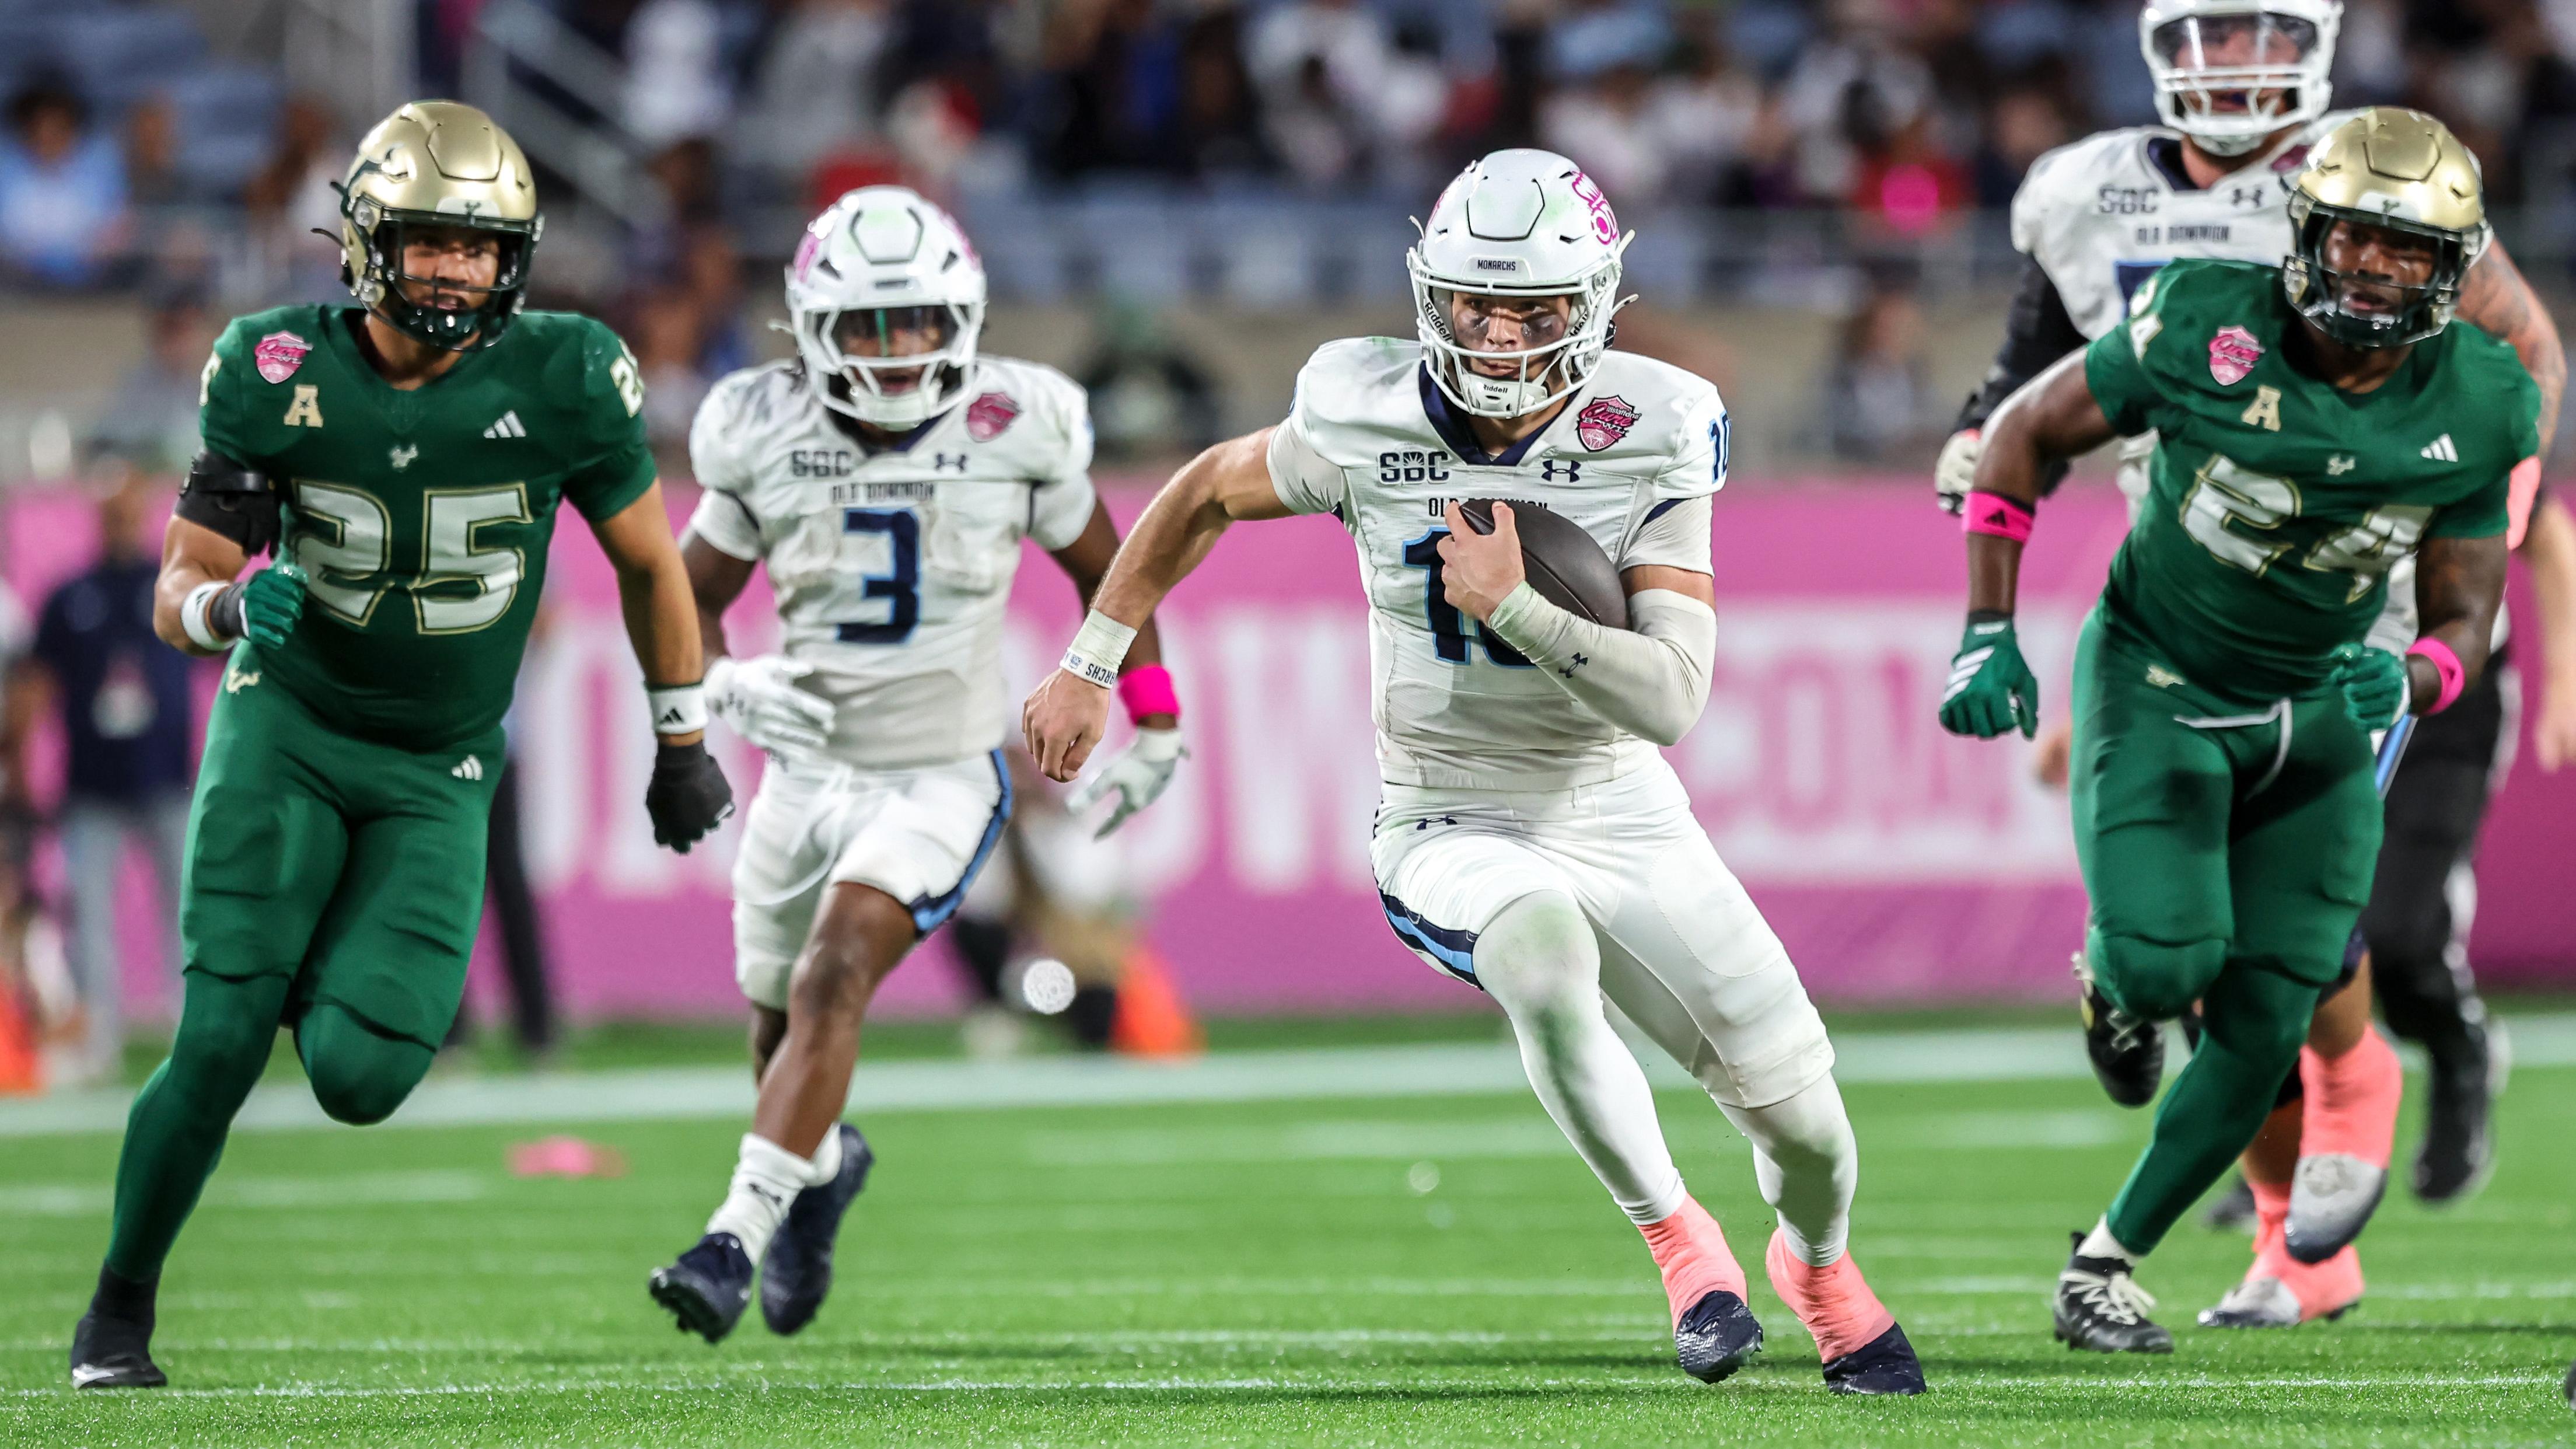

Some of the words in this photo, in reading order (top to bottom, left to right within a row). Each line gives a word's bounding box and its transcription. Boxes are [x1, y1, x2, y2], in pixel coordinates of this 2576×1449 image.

[1477, 259, 1516, 271] MONARCHS
[1424, 302, 1452, 342] Riddell
[1483, 383, 1508, 394] Riddell
[1379, 451, 1449, 483] SBC
[1428, 498, 1458, 518] OL
[2179, 452, 2438, 605] 24
[292, 477, 534, 636] 25
[837, 507, 921, 645] 3
[1401, 525, 1539, 670] 1
